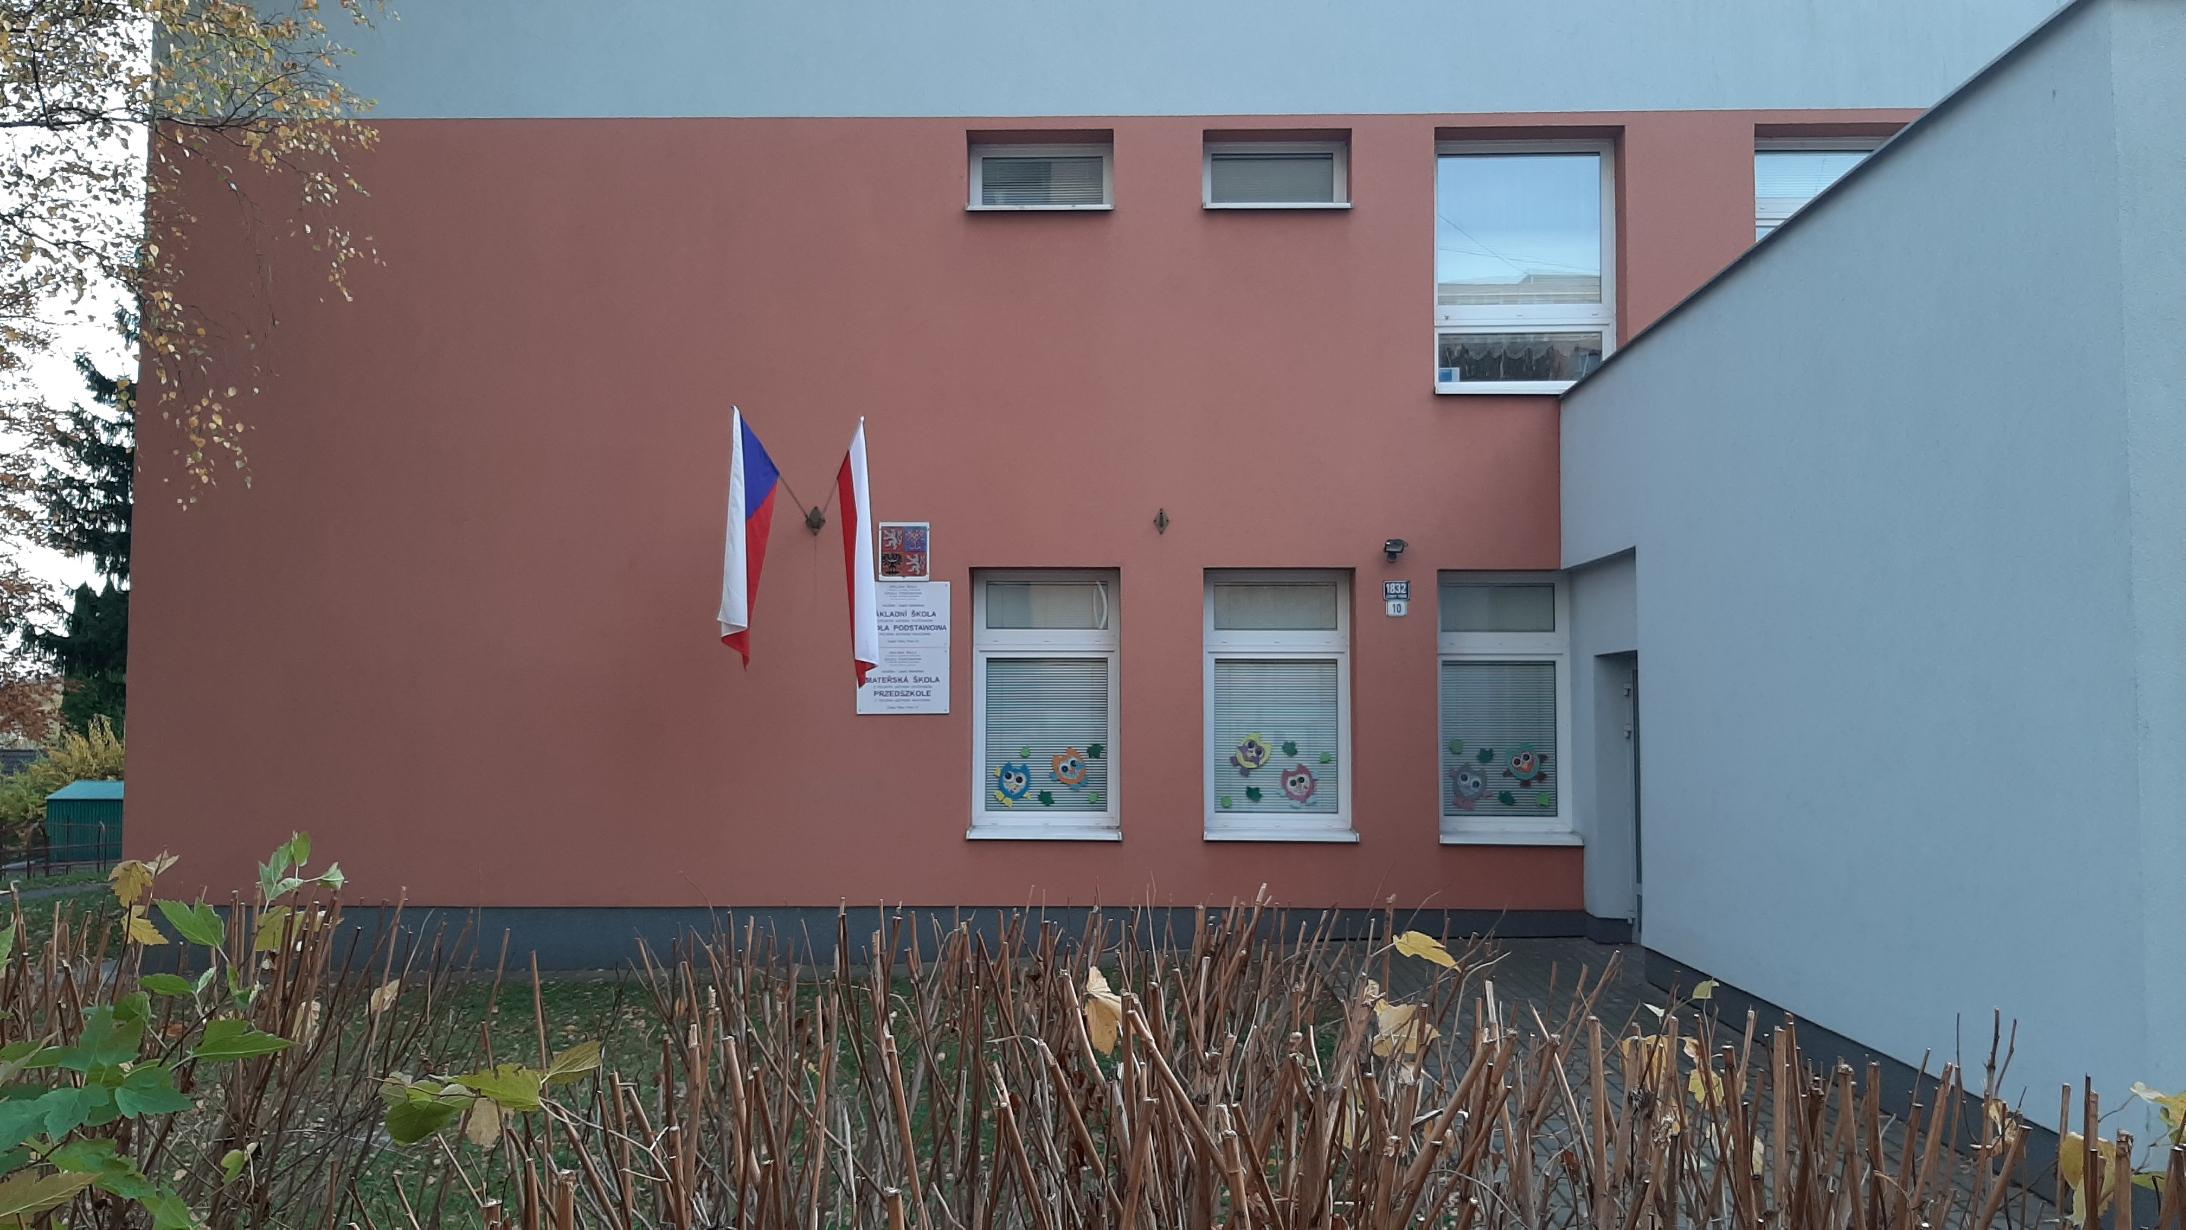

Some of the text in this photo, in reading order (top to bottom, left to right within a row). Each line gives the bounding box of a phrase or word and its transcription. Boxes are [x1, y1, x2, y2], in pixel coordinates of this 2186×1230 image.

[1386, 583, 1406, 593] 1832
[1392, 604, 1401, 613] 10
[911, 609, 936, 617] ŠKOLA
[913, 675, 940, 683] ŠKOLA
